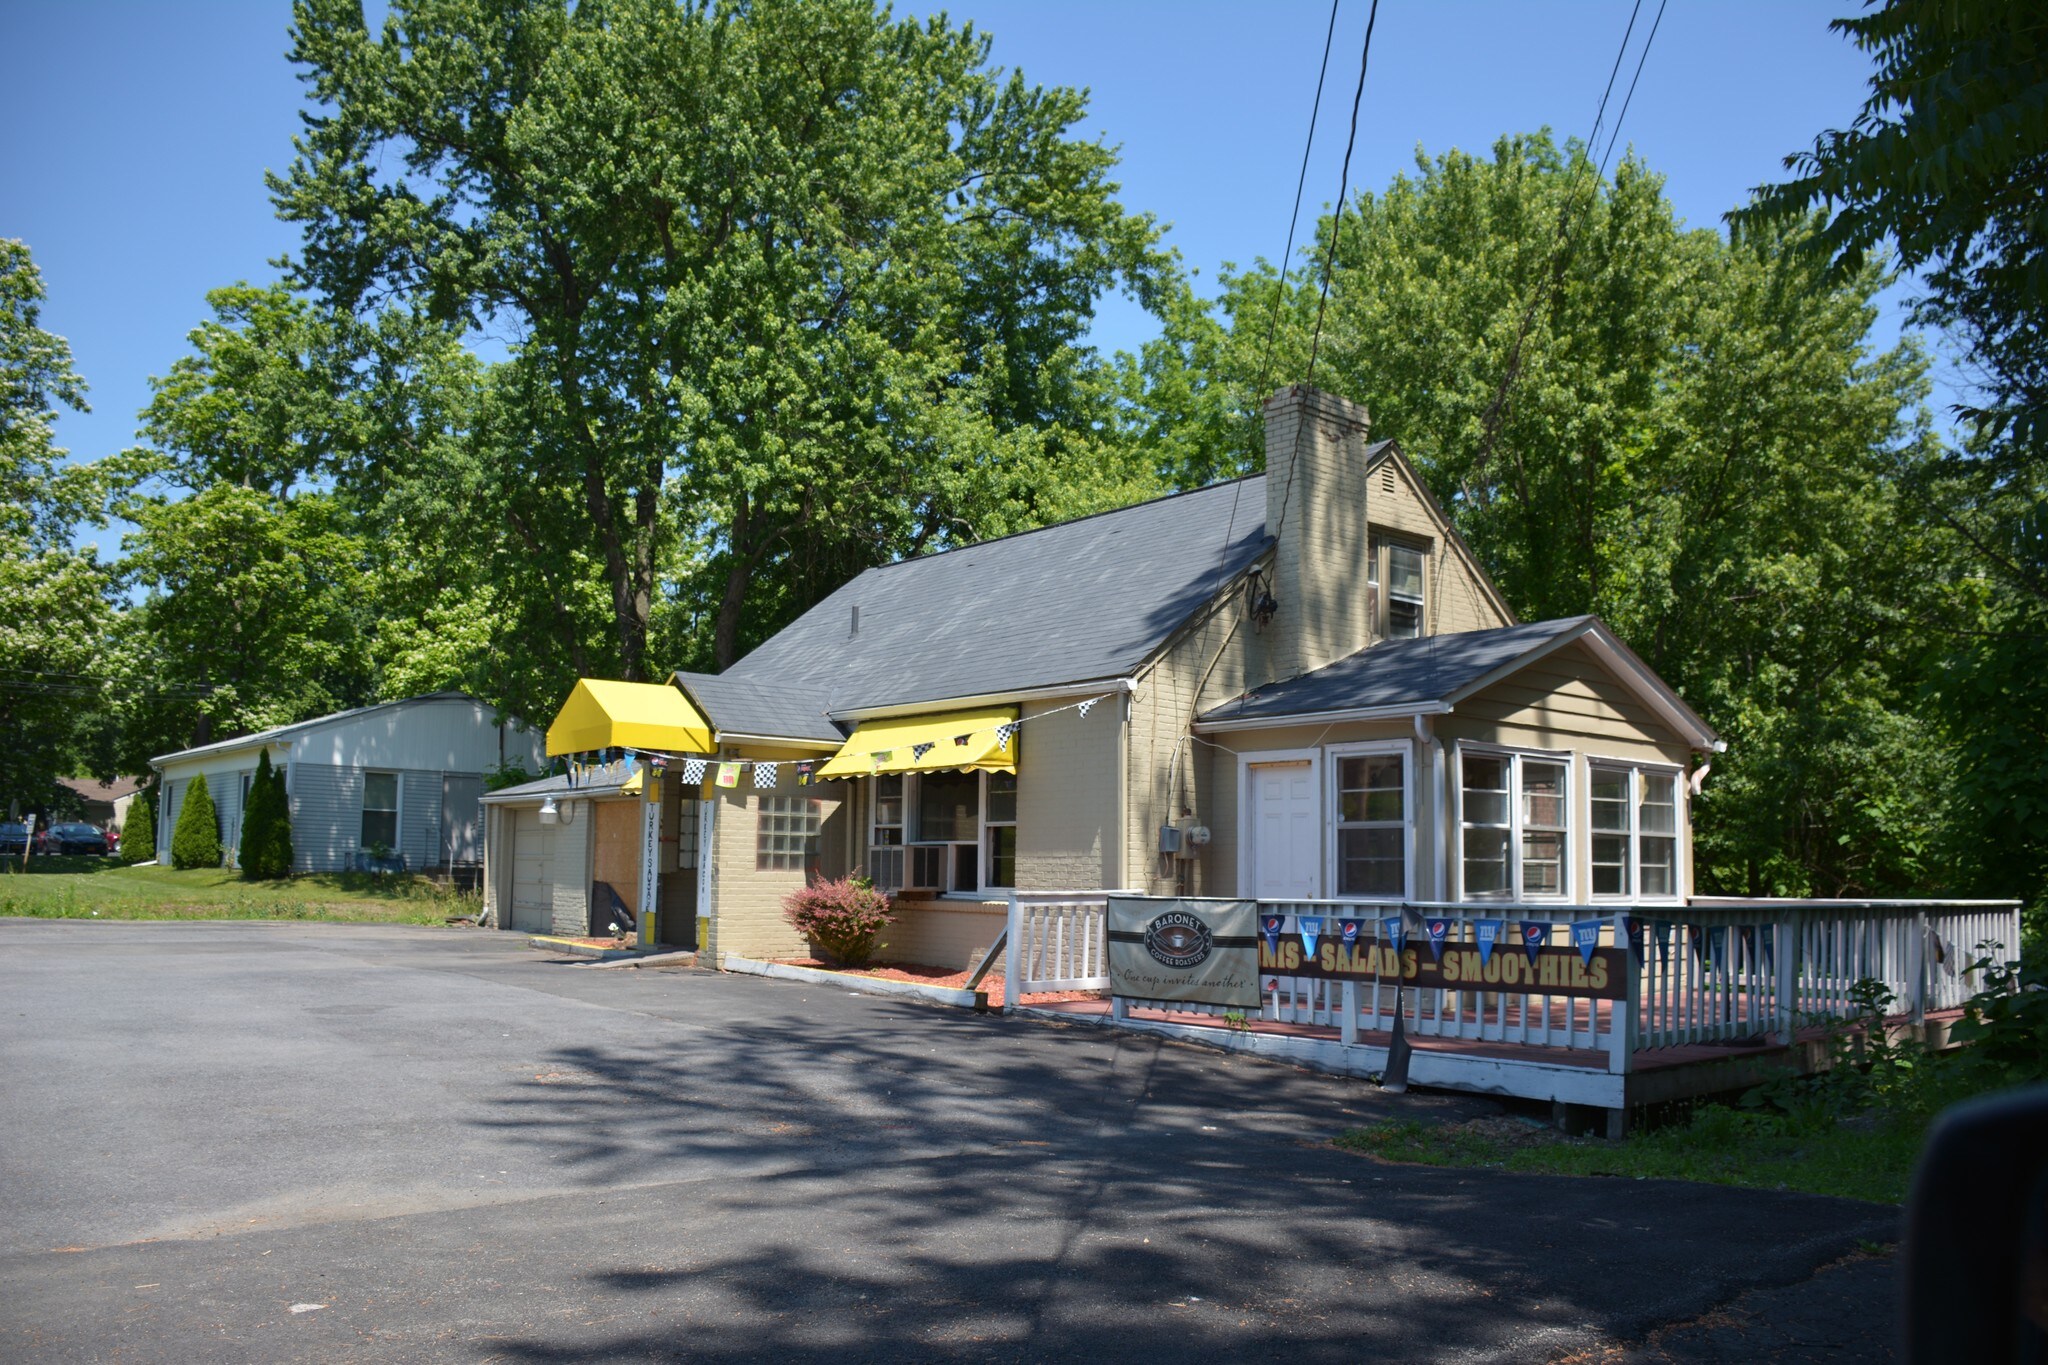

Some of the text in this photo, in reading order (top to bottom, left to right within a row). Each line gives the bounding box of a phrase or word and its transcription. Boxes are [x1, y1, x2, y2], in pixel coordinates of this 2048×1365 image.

[1154, 913, 1201, 930] BARONET
[1150, 948, 1206, 967] COFFEE ROASTERS
[1320, 943, 1418, 980] SALADS
[1442, 950, 1609, 990] SMOOTHIES
[1123, 968, 1247, 991] One cup invites another
